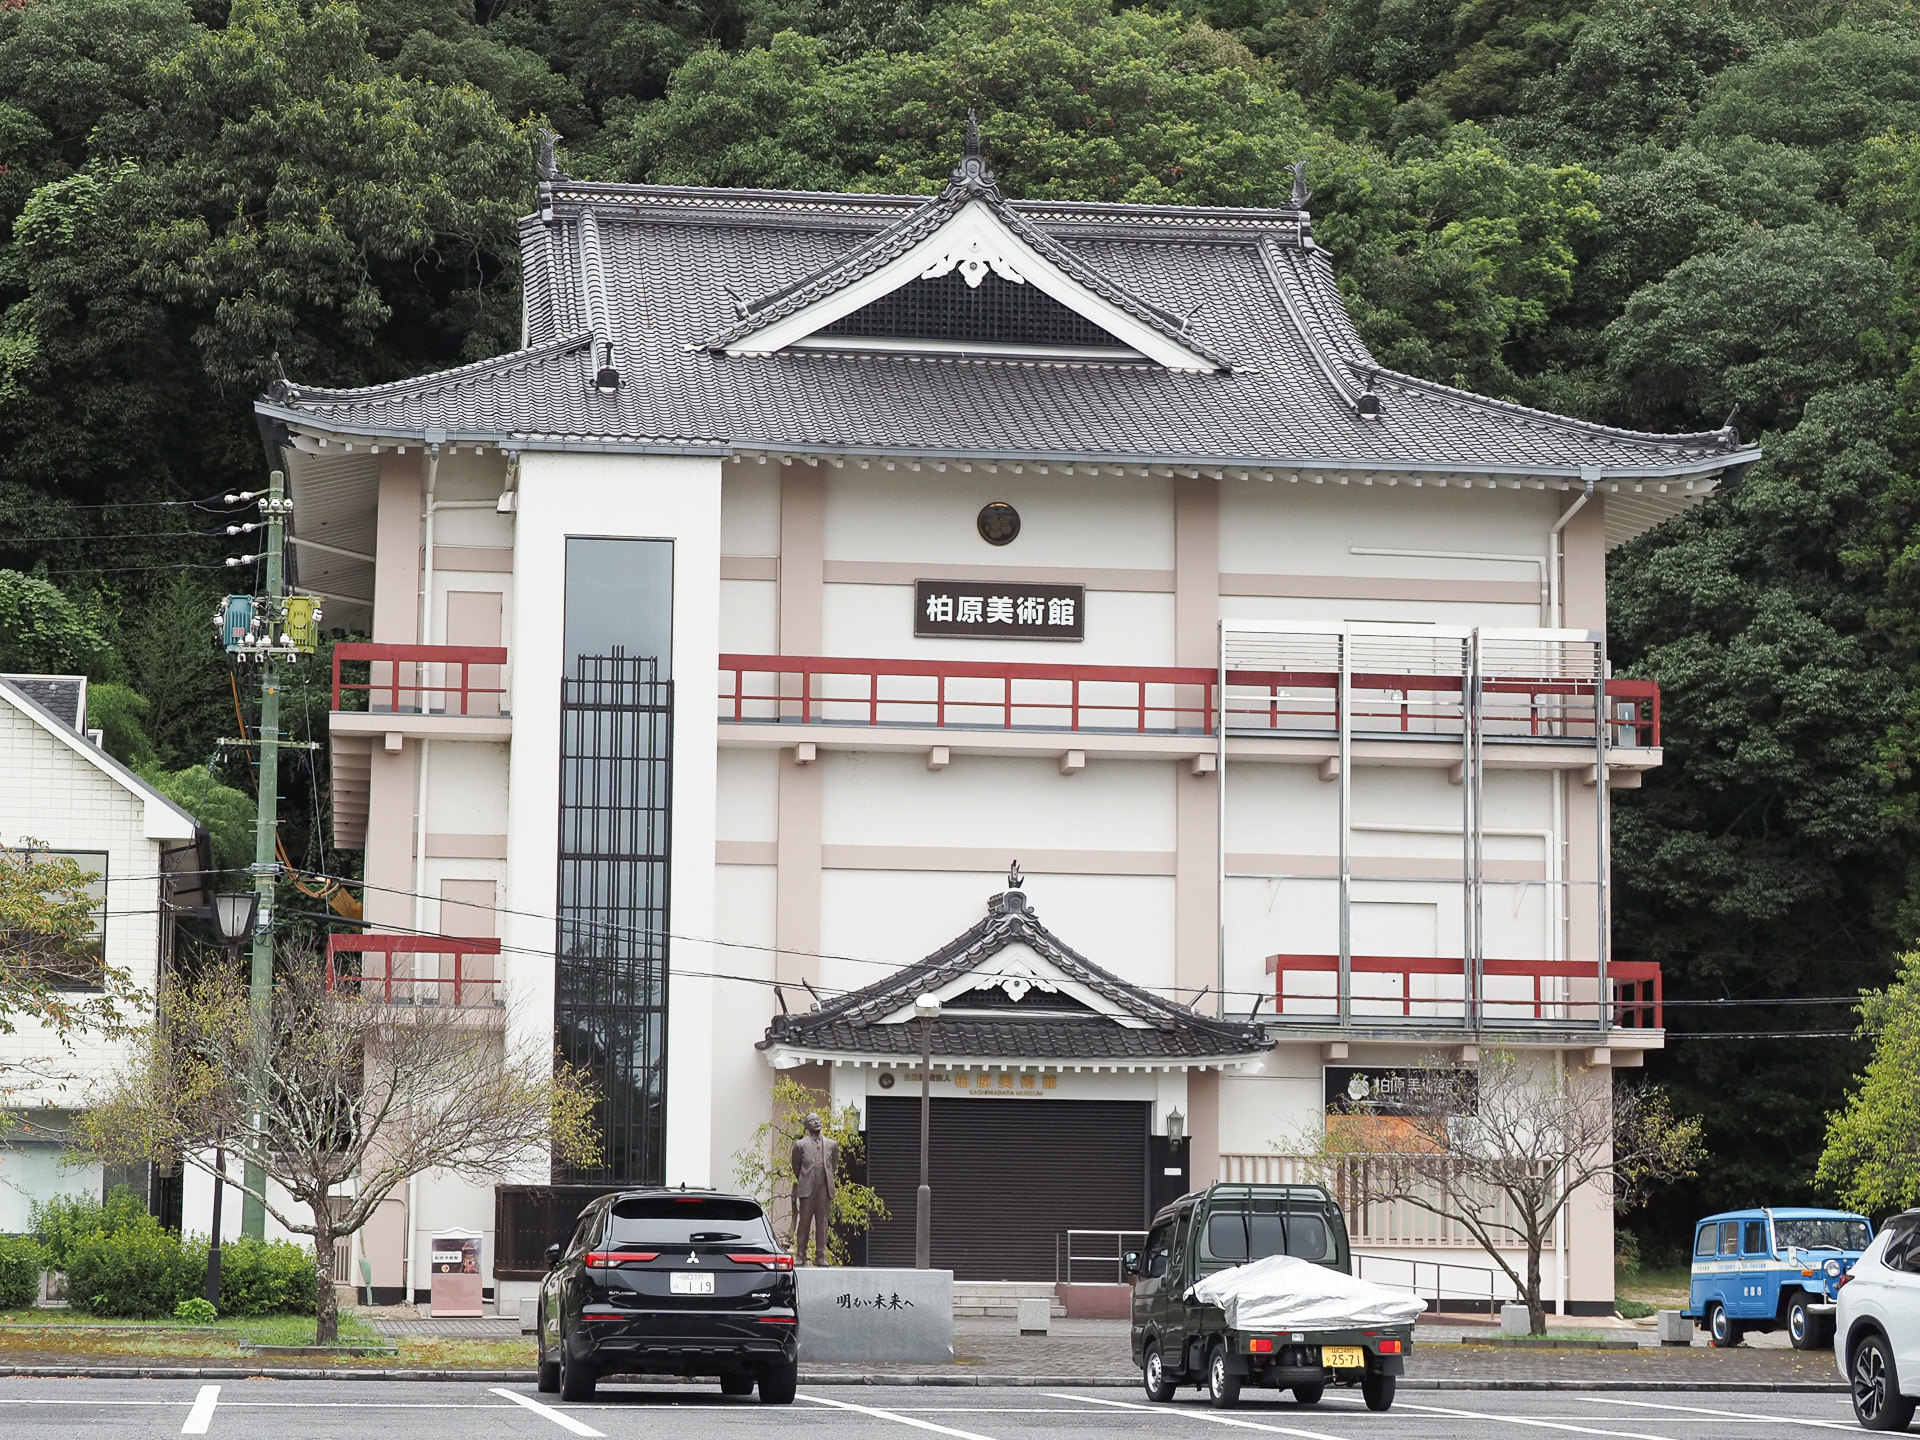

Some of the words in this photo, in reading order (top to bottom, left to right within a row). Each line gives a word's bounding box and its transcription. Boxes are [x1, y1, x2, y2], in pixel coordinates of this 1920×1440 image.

[926, 594, 1075, 626] 柏原美術館
[955, 1073, 1057, 1089] 柏原美術館
